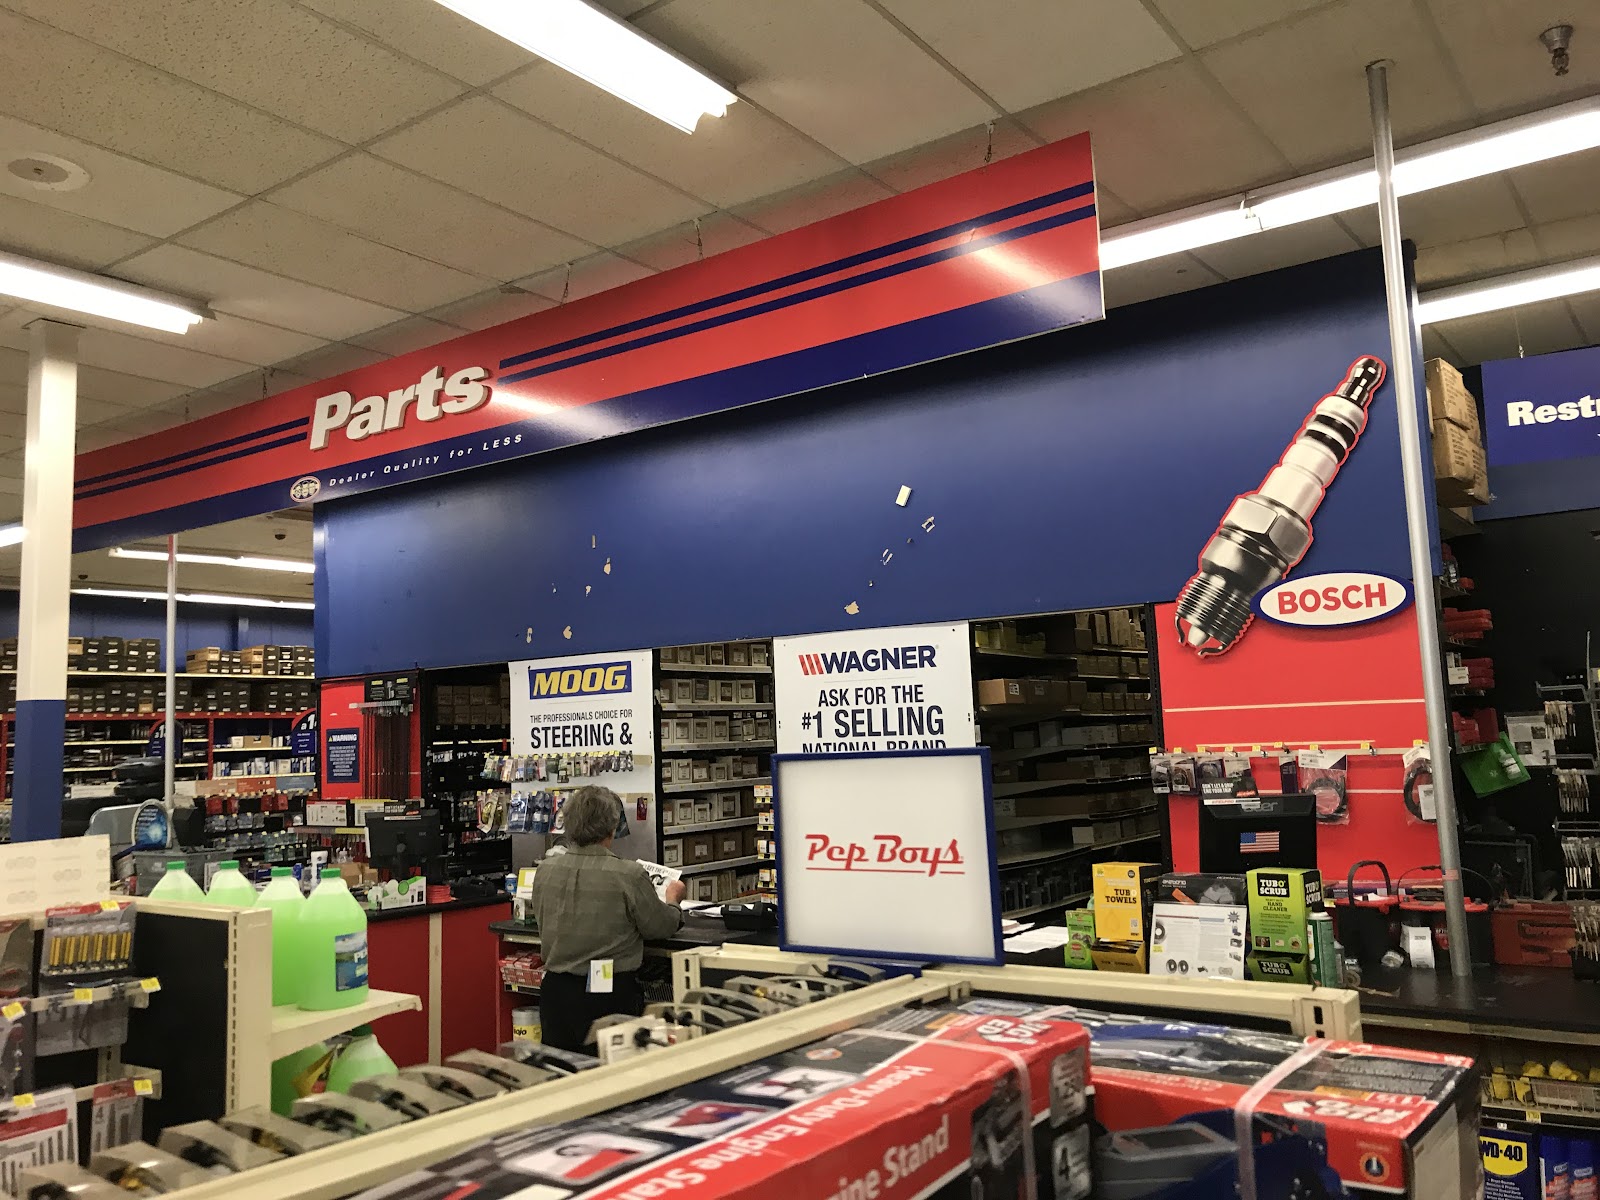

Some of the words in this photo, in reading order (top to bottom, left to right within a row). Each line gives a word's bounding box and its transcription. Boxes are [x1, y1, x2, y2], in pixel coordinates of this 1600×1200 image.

[309, 366, 491, 450] Parts
[329, 469, 375, 487] Dealer
[383, 454, 440, 475] Quality
[449, 446, 473, 459] for
[482, 434, 523, 451] LESS
[1277, 582, 1387, 615] BOSCH
[821, 645, 937, 675] WAGNER
[533, 665, 628, 697] MOOG
[818, 687, 850, 707] ASK
[854, 686, 886, 706] FOR
[891, 684, 924, 703] THE
[530, 715, 542, 723] THE
[543, 711, 593, 723] PROFESSIONALS
[594, 709, 618, 720] CHOICE
[619, 709, 633, 718] FOR
[801, 711, 823, 738] #1
[834, 705, 944, 738] SELLING
[332, 734, 357, 742] WARNING
[530, 723, 614, 749] STEERING
[619, 722, 633, 745] &
[805, 833, 869, 870] Pep
[873, 834, 964, 877] Boys
[1105, 896, 1137, 904] TOWELS
[1260, 887, 1287, 896] SCRUB
[1262, 967, 1290, 975] SCRUB
[788, 1065, 934, 1129] Heavy-Duty
[688, 1119, 810, 1171] Engine
[883, 1113, 950, 1189] Stand
[1481, 1140, 1523, 1161] WD-40
[604, 1167, 707, 1200] Sta
